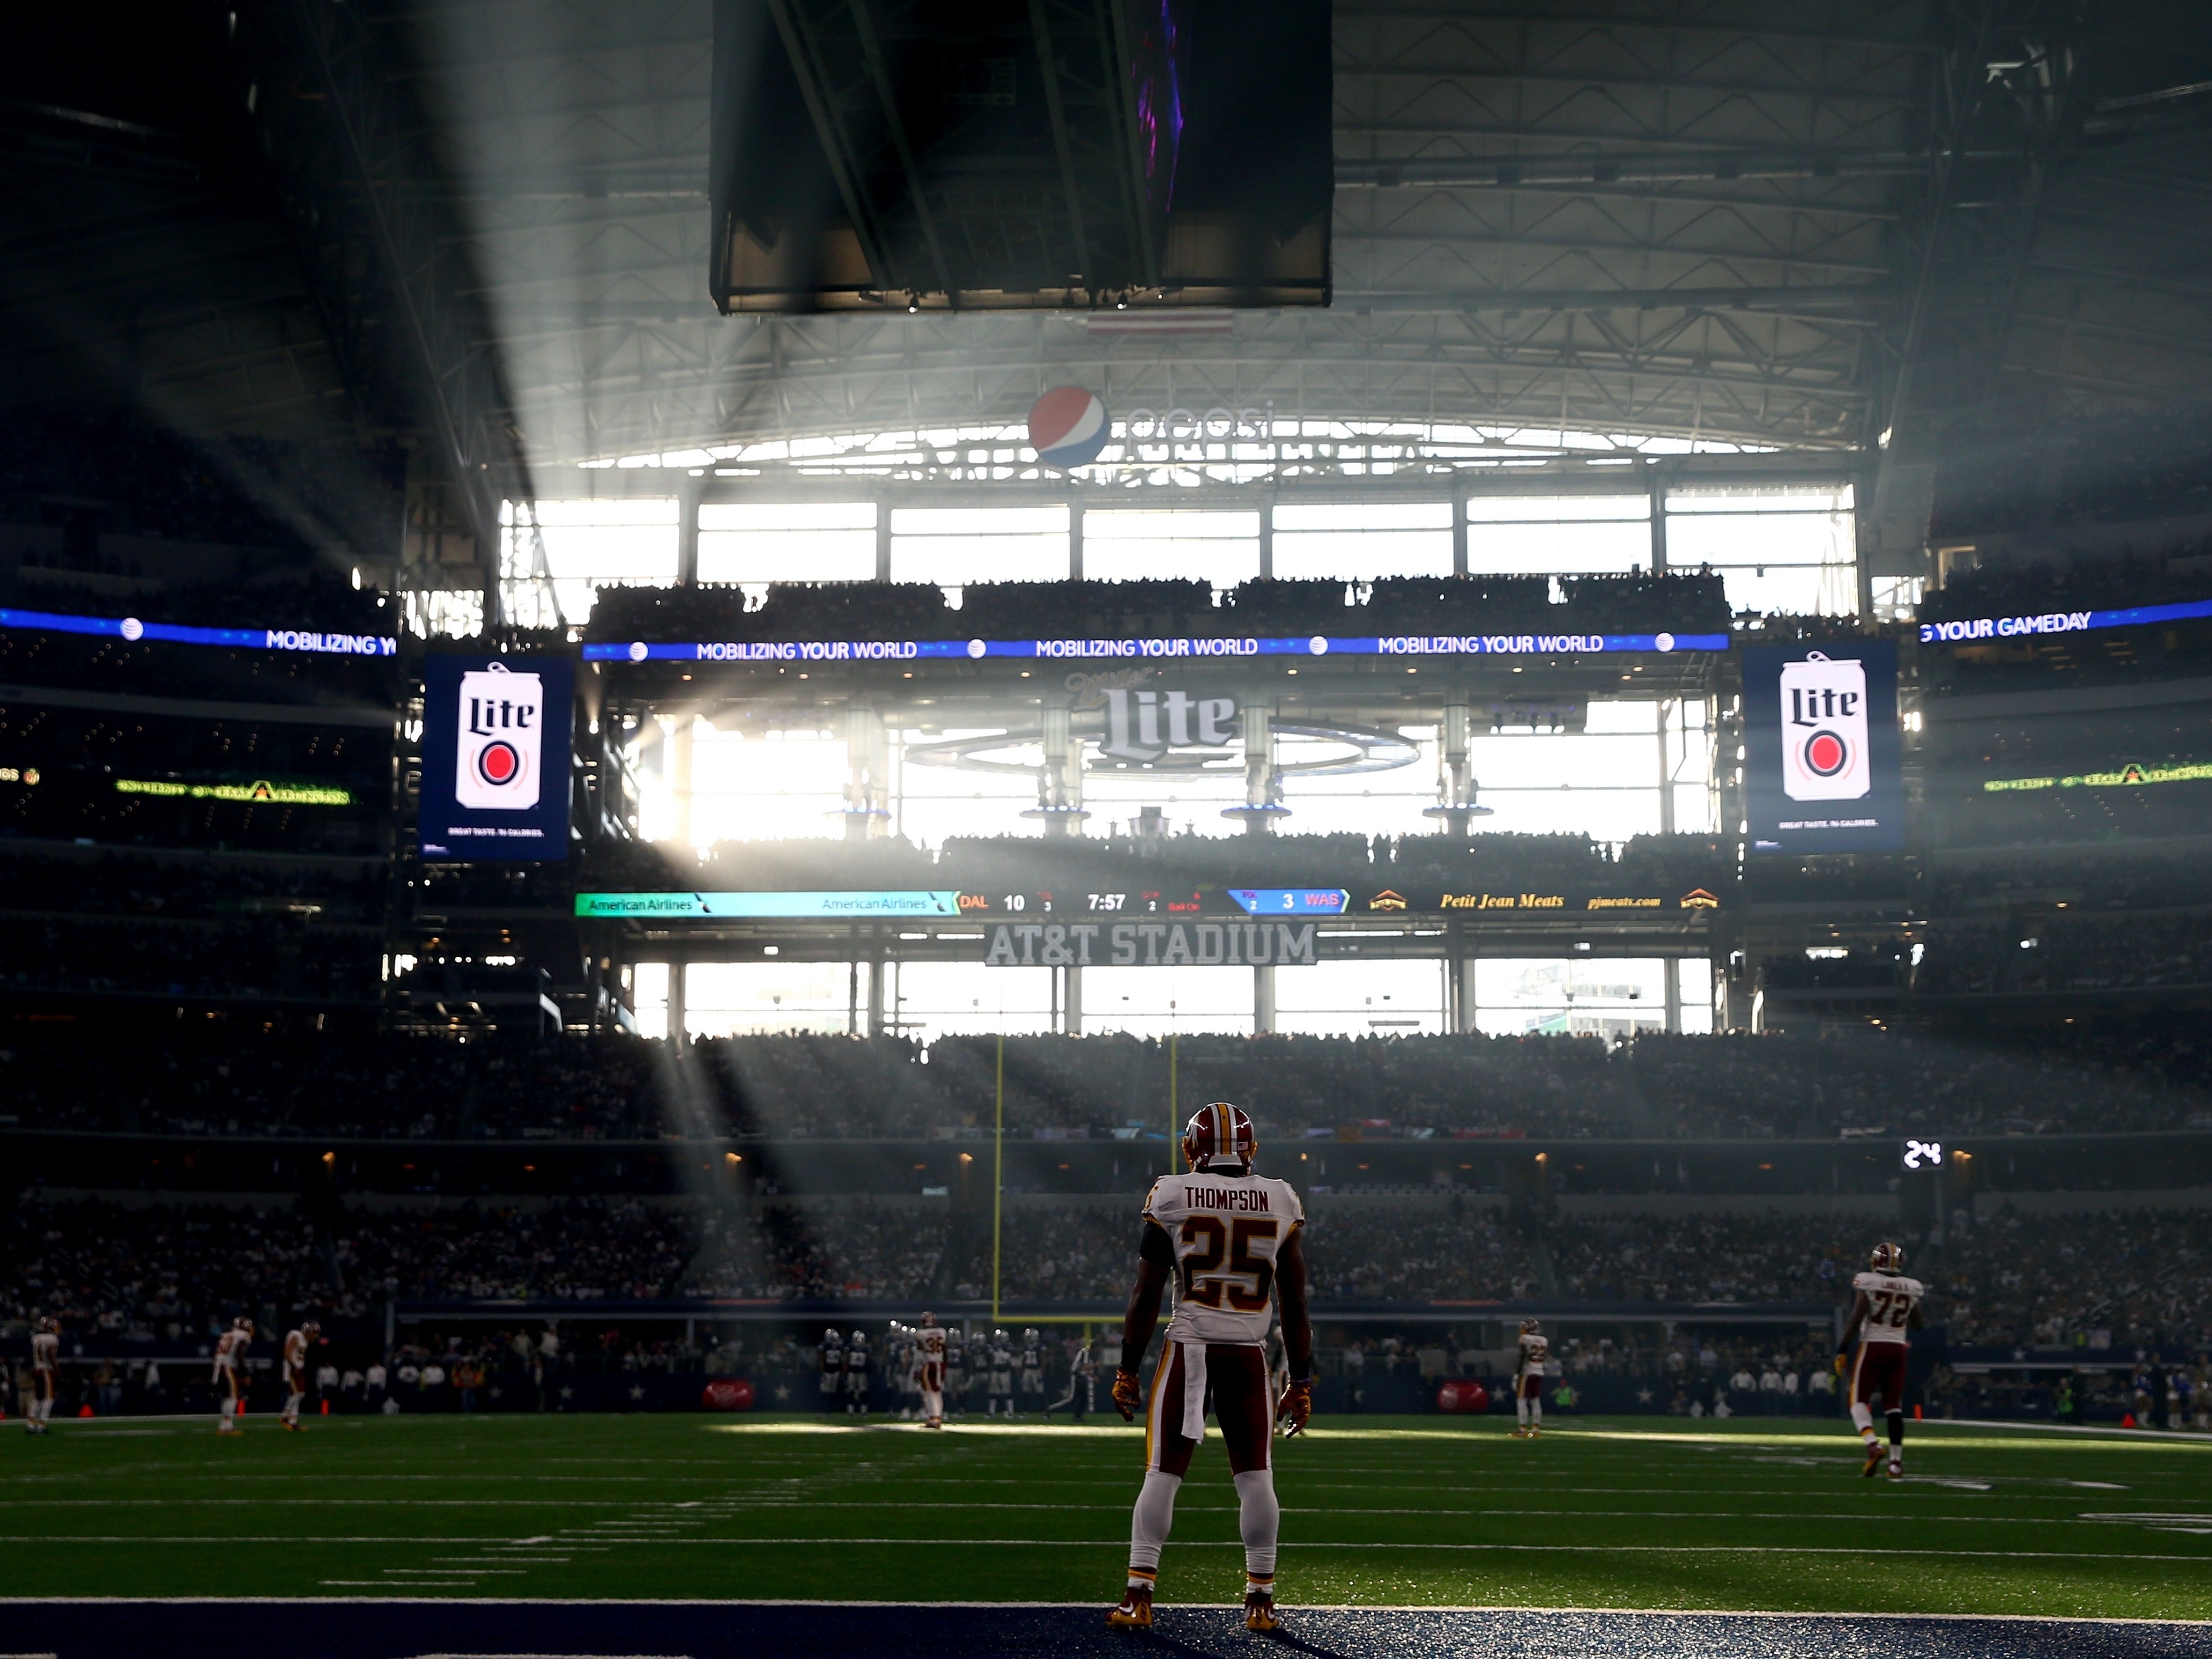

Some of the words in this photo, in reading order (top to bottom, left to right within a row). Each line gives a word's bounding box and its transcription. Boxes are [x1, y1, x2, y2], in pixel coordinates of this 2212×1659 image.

[1126, 399, 1275, 457] pepsi
[1935, 617, 1994, 641] YOUR
[1997, 611, 2092, 636] GAMEDAY
[266, 629, 377, 655] MOBILIZING
[696, 642, 796, 661] MOBILIZING
[798, 642, 850, 660] YOUR
[852, 641, 918, 659] WORLD
[1036, 639, 1136, 658] MOBILIZING
[1138, 638, 1190, 656] YOUR
[1192, 638, 1259, 656] WORLD
[1378, 636, 1480, 654] MOBILIZING
[1482, 635, 1535, 653] YOUR
[1537, 635, 1604, 653] WORLD
[1065, 667, 1155, 711] Miller
[468, 697, 534, 737] Lite
[1789, 687, 1859, 728] Lite
[1100, 687, 1236, 762] Lite
[590, 900, 648, 912] American
[648, 899, 692, 910] Airlines
[822, 898, 881, 910] American
[881, 897, 927, 909] Airlines
[960, 896, 989, 909] DAL
[1004, 894, 1025, 911] 10
[1044, 901, 1051, 912] 3
[1088, 894, 1126, 911] 7:57
[1149, 901, 1156, 912] 2
[1250, 900, 1257, 910] 2
[1282, 893, 1295, 909] 3
[1306, 894, 1339, 906] WAS
[1440, 894, 1476, 908] Petit
[1478, 894, 1515, 909] Jean
[1518, 894, 1565, 908] Meats
[1587, 896, 1661, 909] pjmeats.com
[986, 925, 1099, 965] AT&T
[1111, 923, 1316, 965] STADIUM
[1904, 1139, 1942, 1169] 24
[1185, 1186, 1269, 1212] THOMPSON
[1180, 1214, 1279, 1313] 25
[1871, 1290, 1910, 1328] 72
